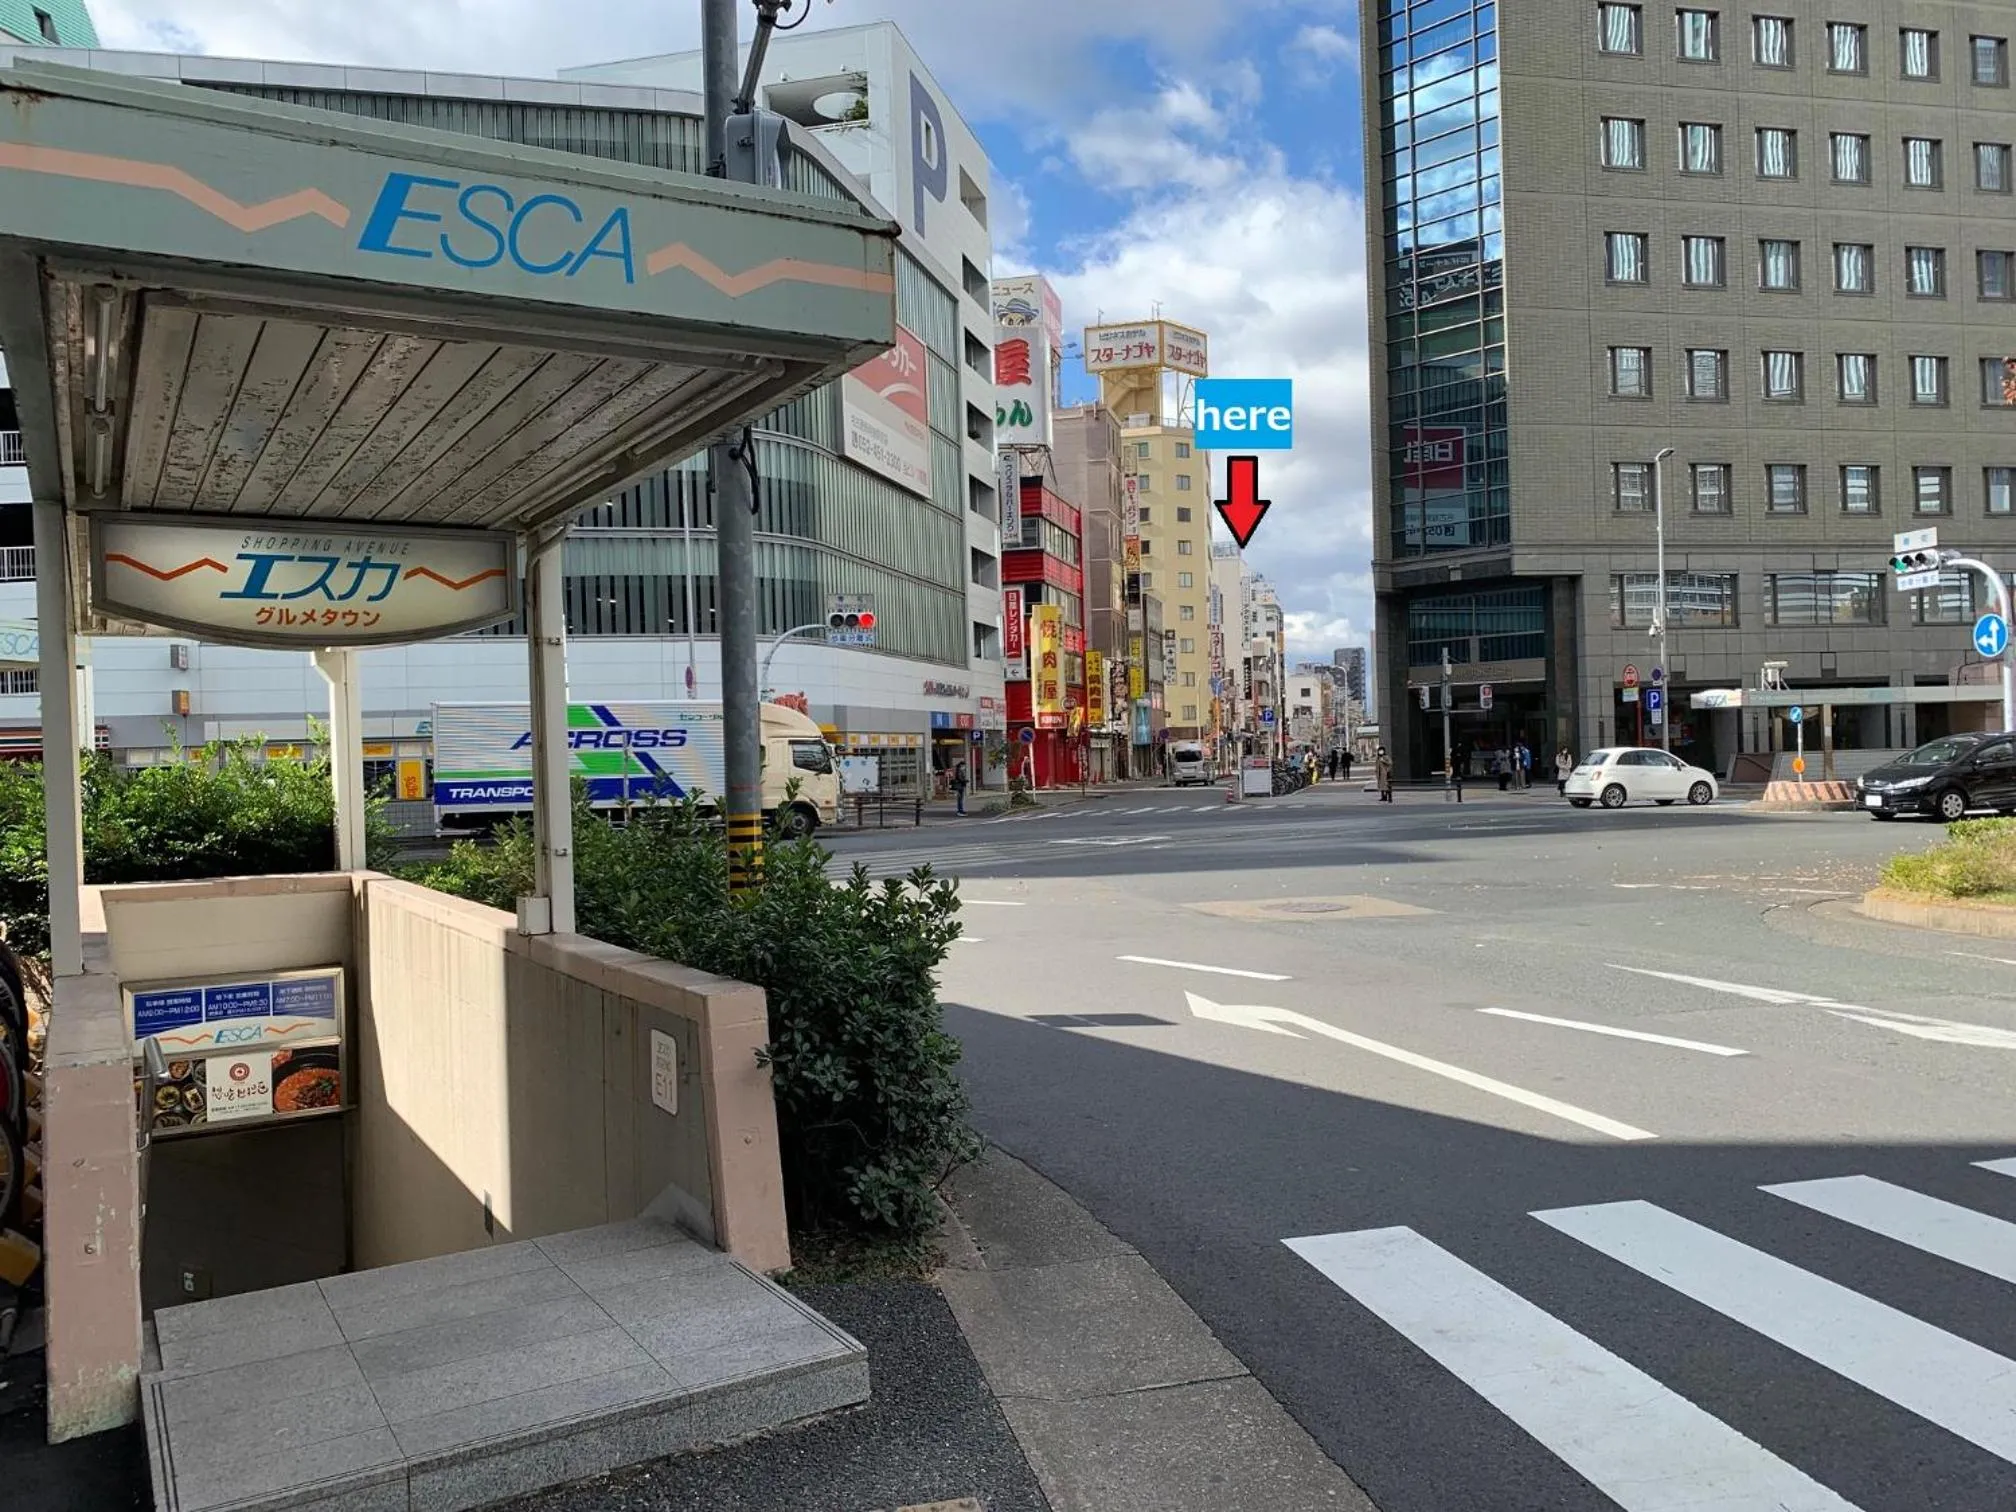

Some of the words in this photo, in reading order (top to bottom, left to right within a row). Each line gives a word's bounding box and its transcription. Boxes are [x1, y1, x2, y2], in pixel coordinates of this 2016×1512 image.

[910, 69, 947, 240] P
[357, 172, 635, 284] ESCA
[1091, 341, 1155, 363] スターナゴヤ
[1168, 344, 1207, 368] スターナゴヤ
[241, 535, 333, 552] SHOPPING
[343, 540, 411, 556] AVENUE
[219, 552, 402, 602] エスカ
[255, 606, 381, 627] グルメタウン
[1008, 592, 1020, 648] 日産レンタカー
[1042, 620, 1057, 700] 焼肉屋
[1650, 692, 1659, 708] P
[509, 729, 688, 751] AROSS
[972, 730, 981, 740] P
[214, 1022, 263, 1044] ESCA
